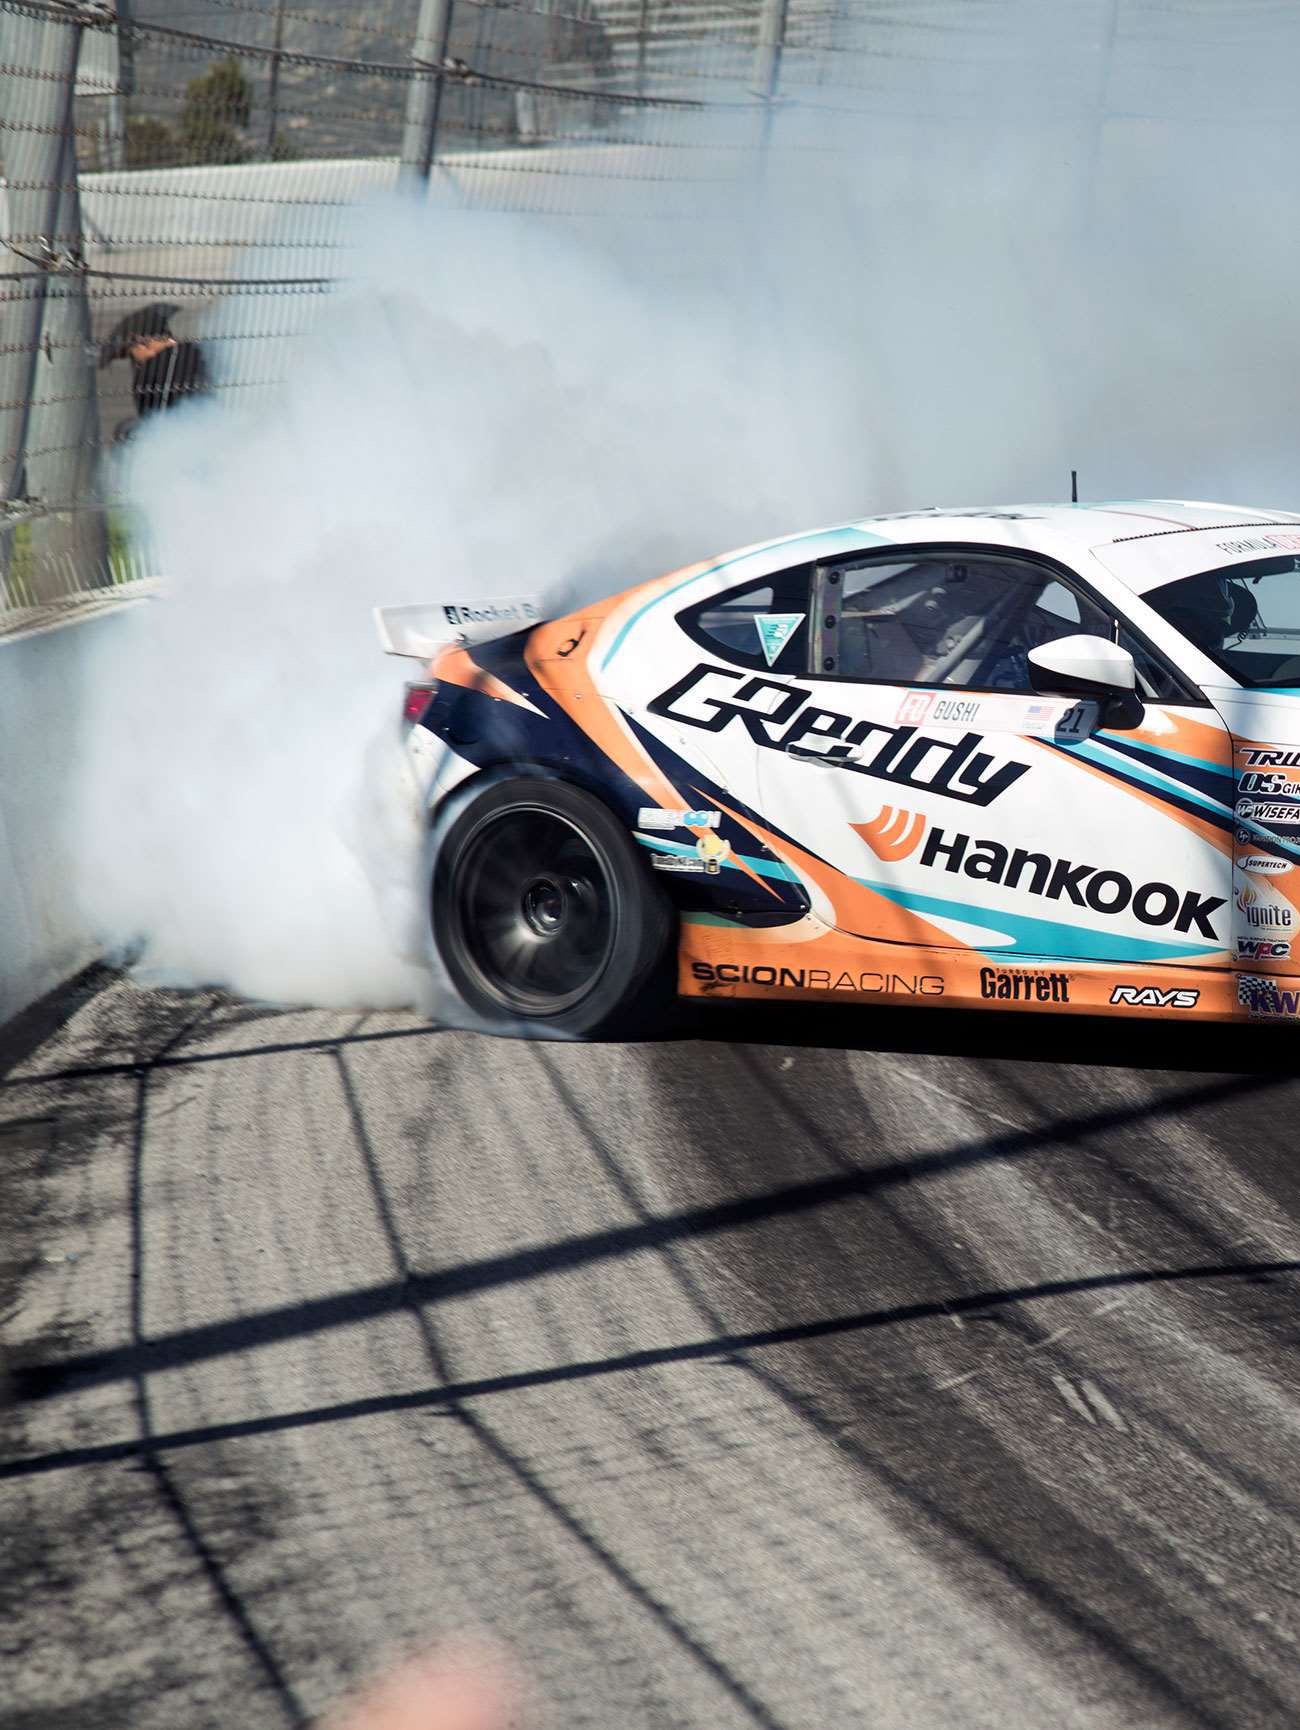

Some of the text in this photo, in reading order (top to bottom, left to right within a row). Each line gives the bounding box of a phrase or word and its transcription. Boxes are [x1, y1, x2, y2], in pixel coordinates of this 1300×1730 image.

[933, 701, 981, 721] GUSHI
[1056, 708, 1086, 733] 21
[1240, 773, 1286, 794] OS
[1248, 860, 1287, 868] SUPERTECH
[1246, 904, 1292, 928] ignite
[980, 967, 1070, 1002] Garrett
[1111, 986, 1200, 1006] RAYS
